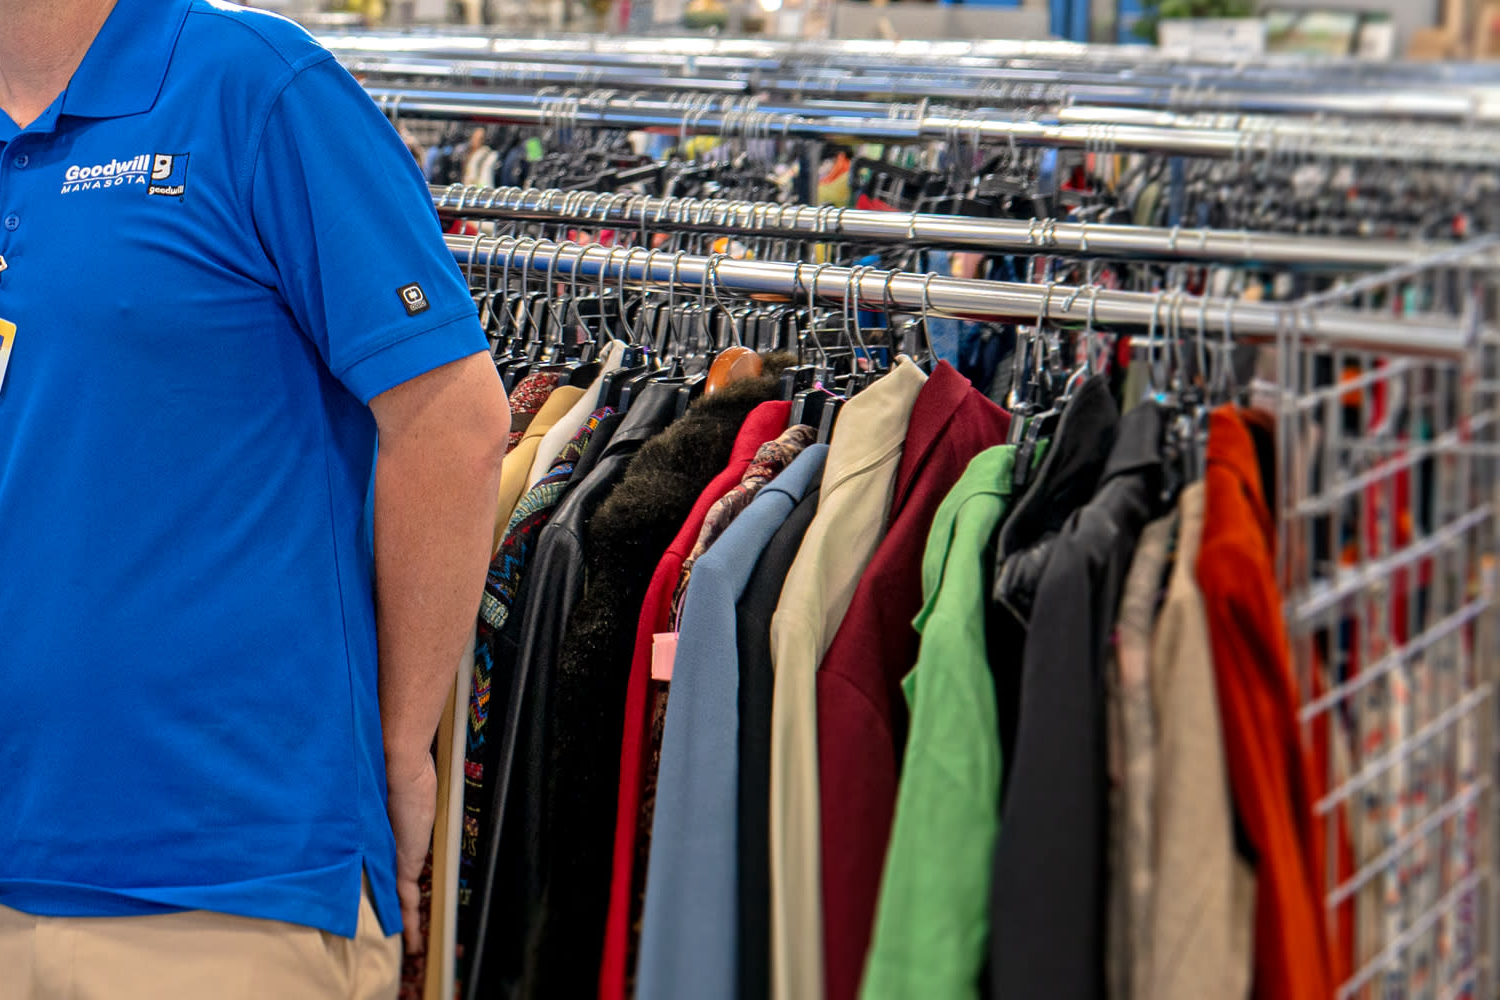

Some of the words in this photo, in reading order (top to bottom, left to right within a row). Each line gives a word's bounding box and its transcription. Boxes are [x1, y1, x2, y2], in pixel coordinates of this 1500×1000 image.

[65, 154, 150, 180] Goodwill
[61, 175, 145, 194] MANASOTA
[148, 185, 184, 195] goodwill
